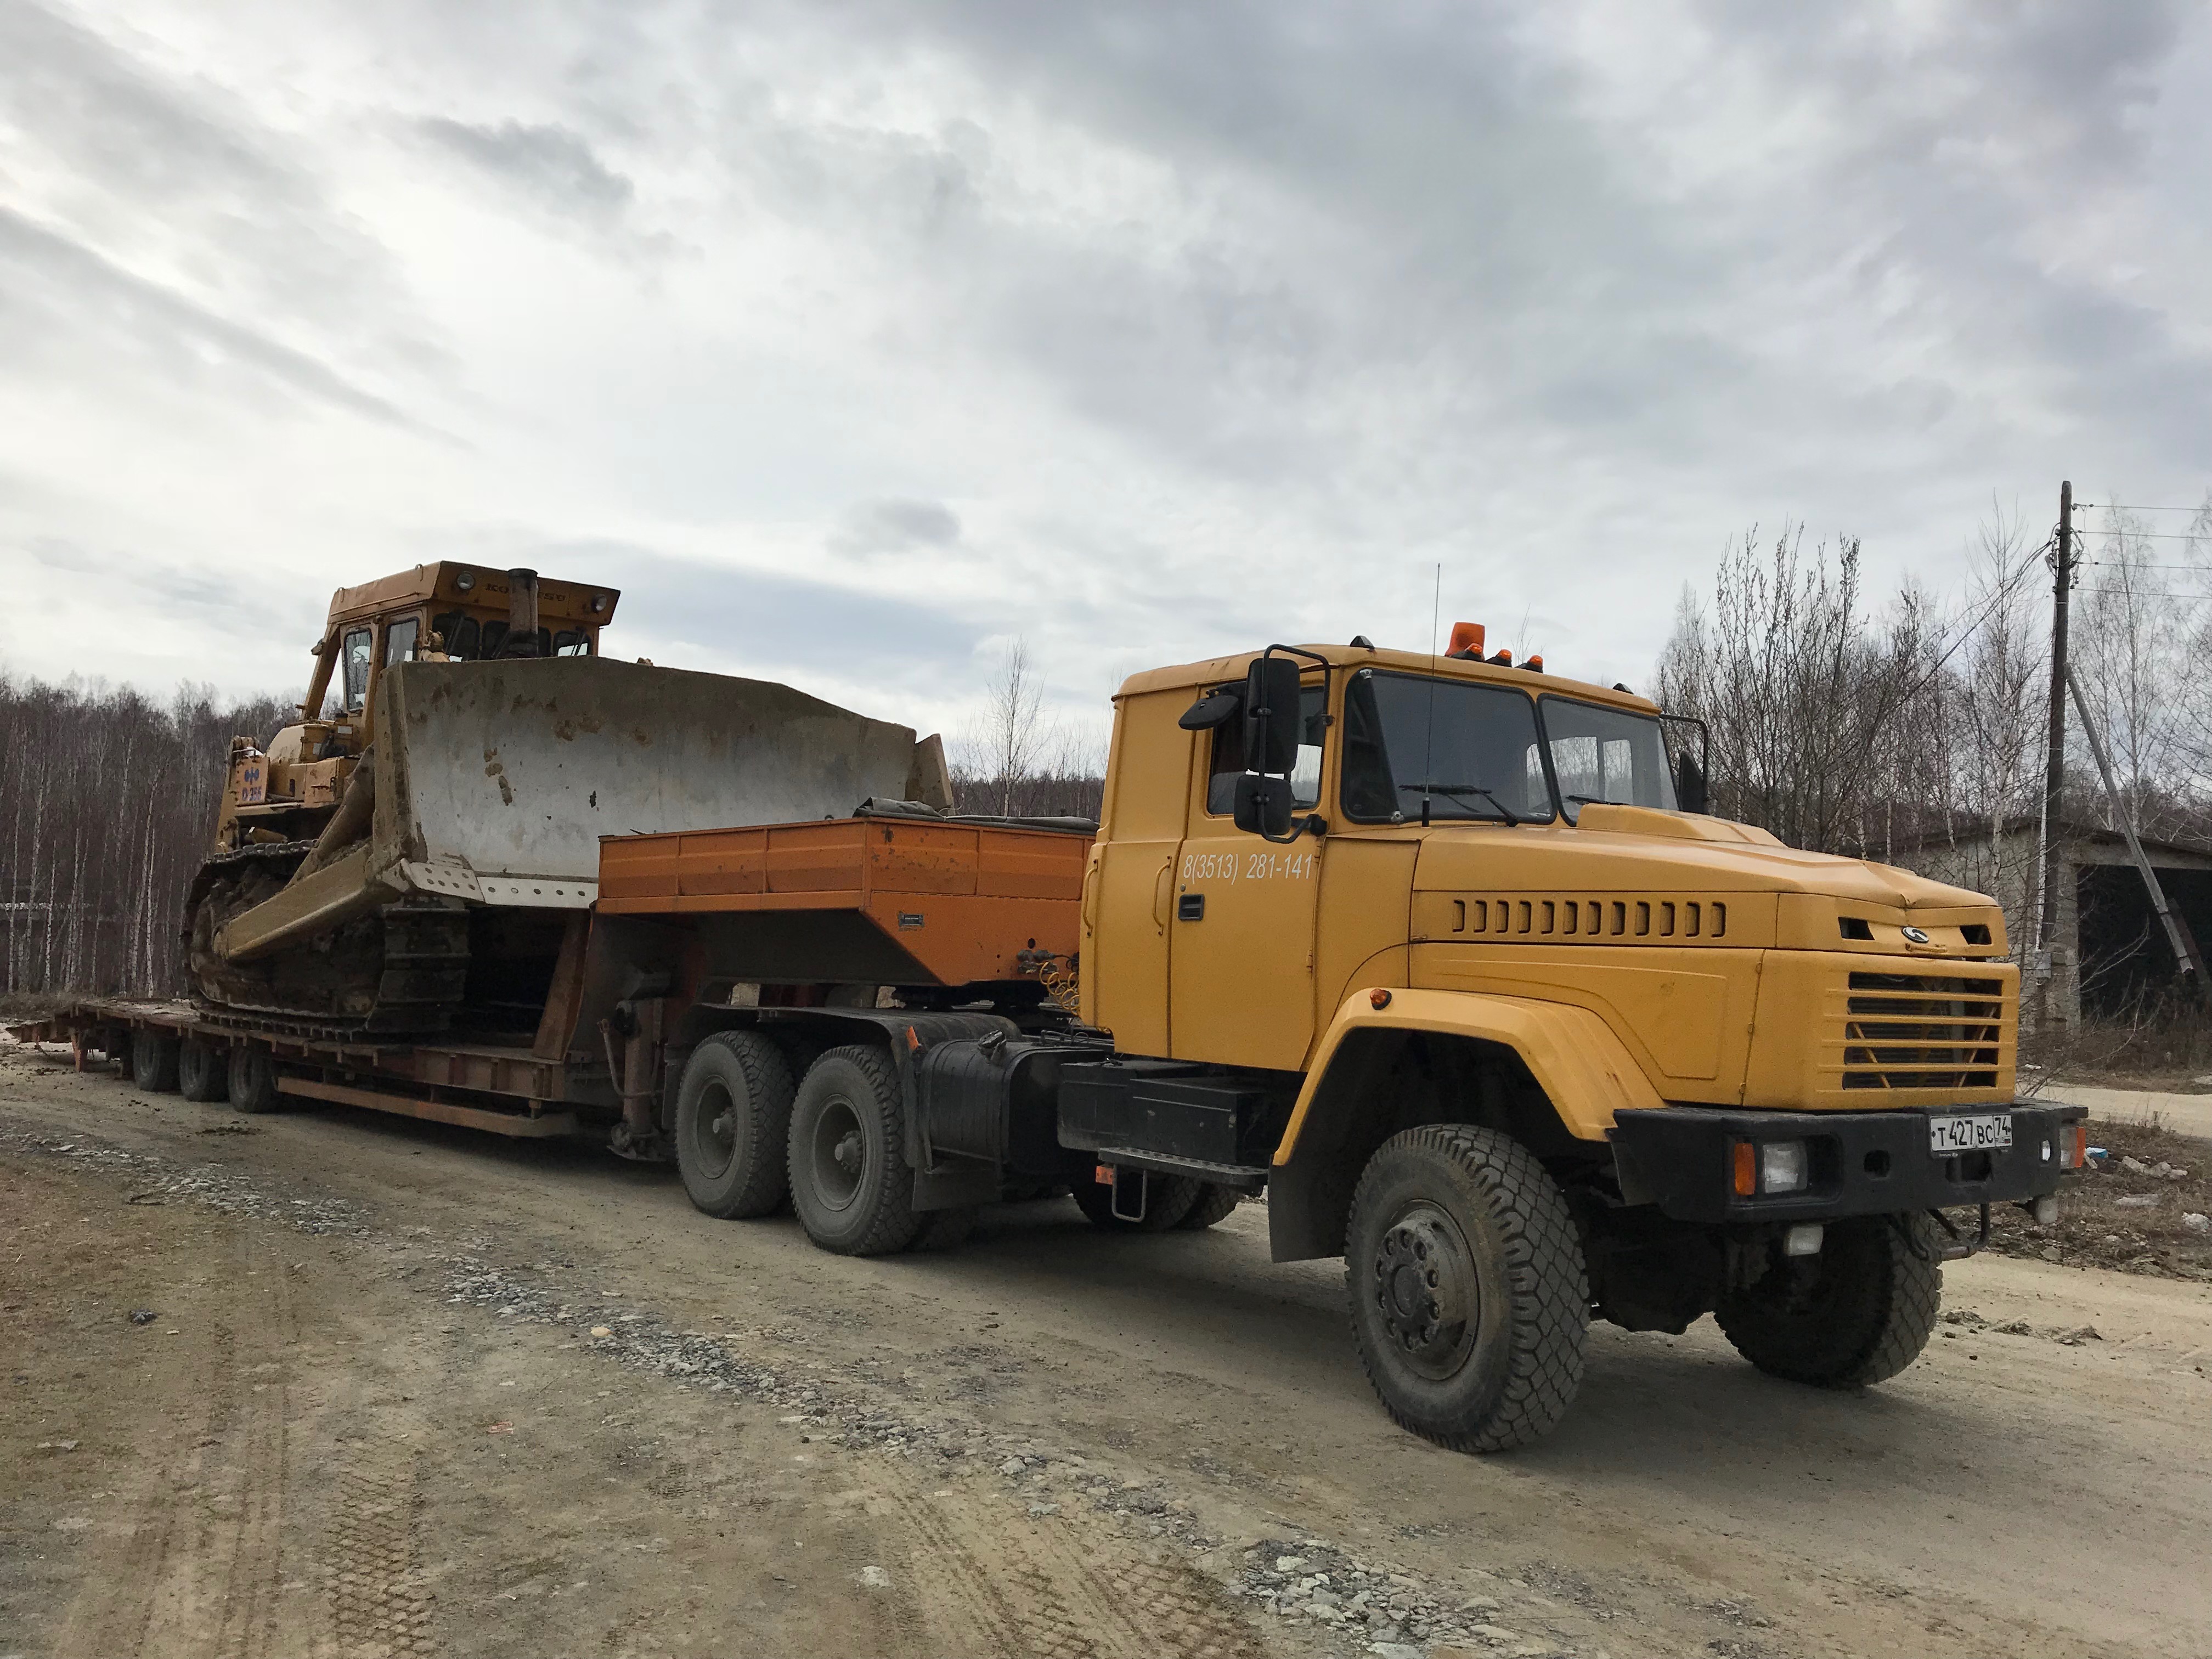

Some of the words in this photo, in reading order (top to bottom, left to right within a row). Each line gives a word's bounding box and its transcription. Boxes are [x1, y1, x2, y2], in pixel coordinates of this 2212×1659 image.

[1183, 854, 1239, 885] 8(3513)
[1246, 854, 1312, 879] 281-141
[1995, 1116, 2008, 1136] 74
